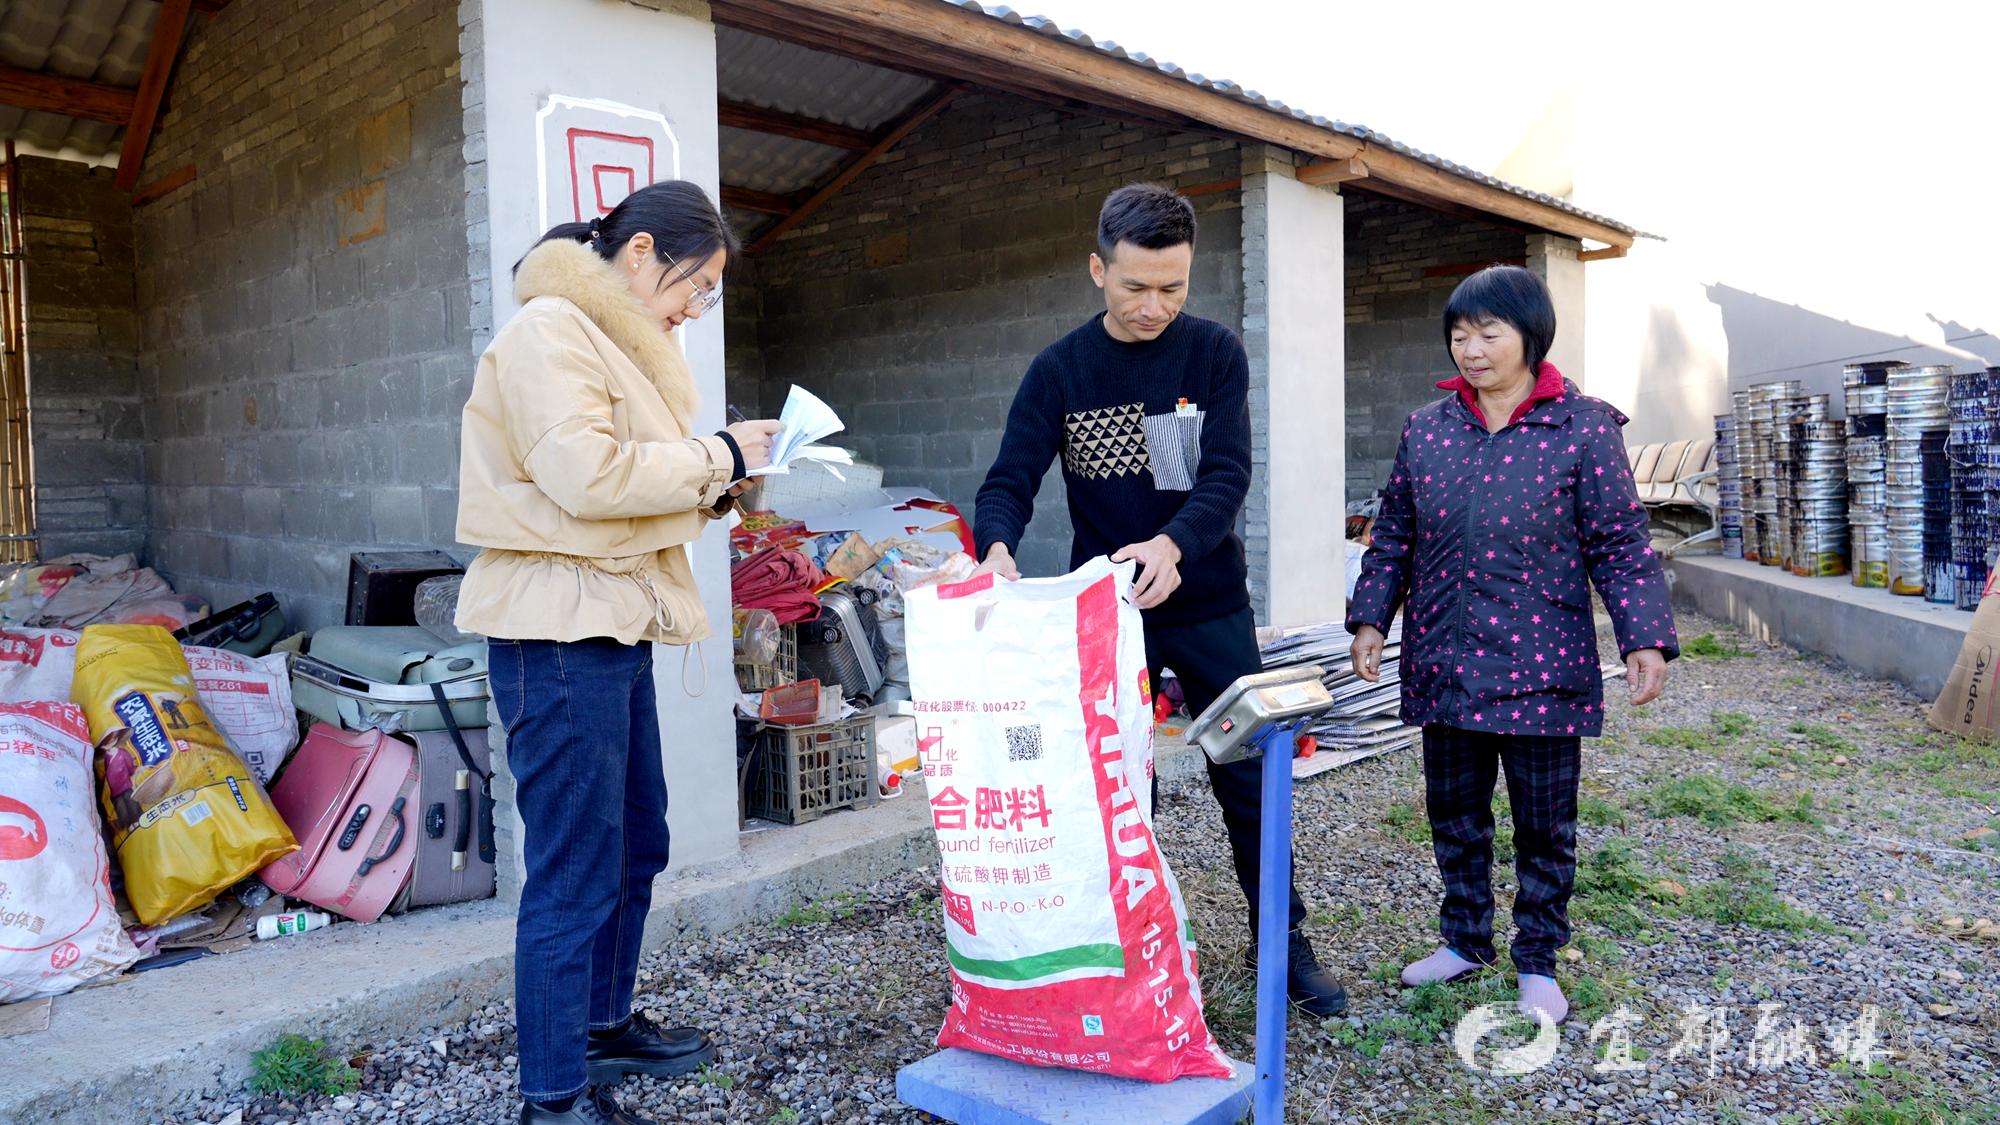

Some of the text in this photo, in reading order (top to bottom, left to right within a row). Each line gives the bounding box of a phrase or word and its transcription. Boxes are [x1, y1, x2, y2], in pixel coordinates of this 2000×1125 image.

[1963, 644, 1992, 725] Midea
[983, 700, 1026, 713] 000422
[120, 696, 168, 762] 农家生态米
[924, 764, 953, 777] 品质
[146, 793, 186, 823] 生态米
[930, 784, 1053, 833] 合肥料
[55, 944, 79, 962] 40
[1142, 922, 1190, 1052] 15-15-15
